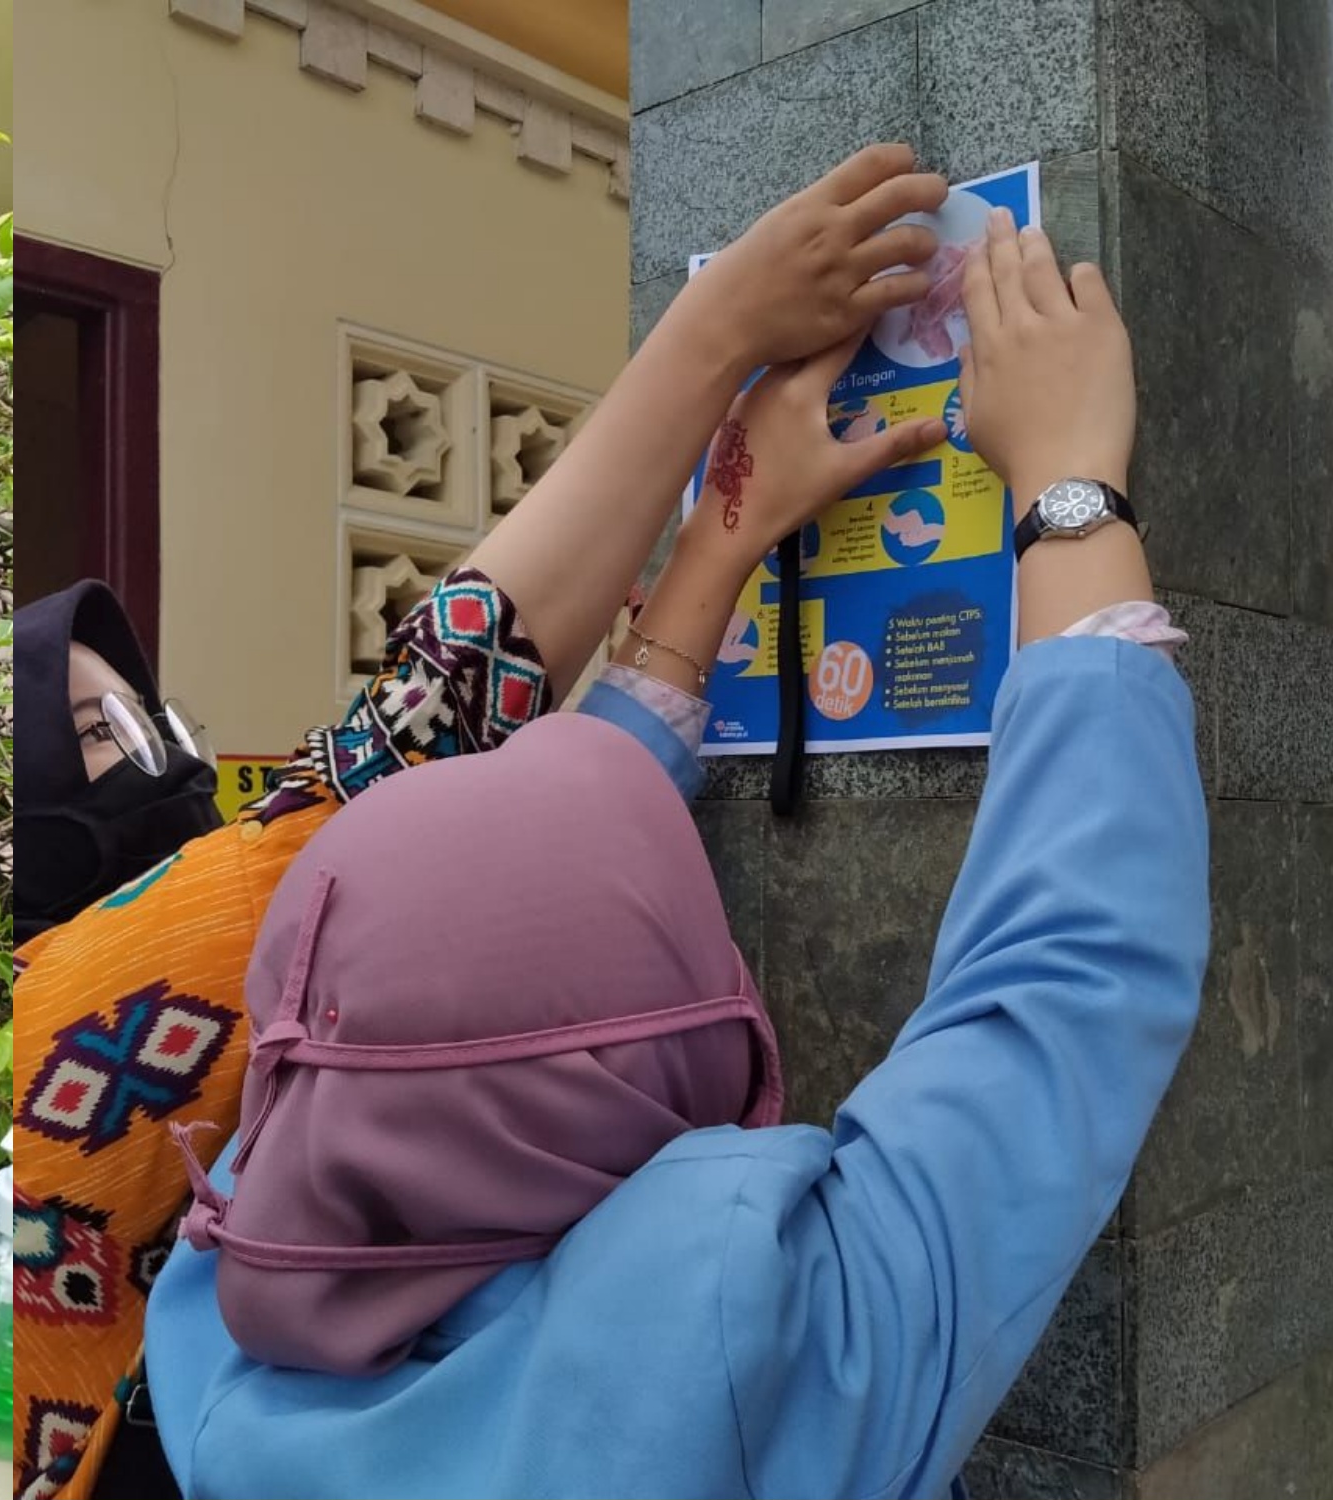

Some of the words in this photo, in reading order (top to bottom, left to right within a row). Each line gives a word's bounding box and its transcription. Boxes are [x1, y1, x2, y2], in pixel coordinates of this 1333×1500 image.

[851, 369, 896, 387] Tangan
[817, 642, 867, 698] 60
[815, 692, 855, 715] detik
